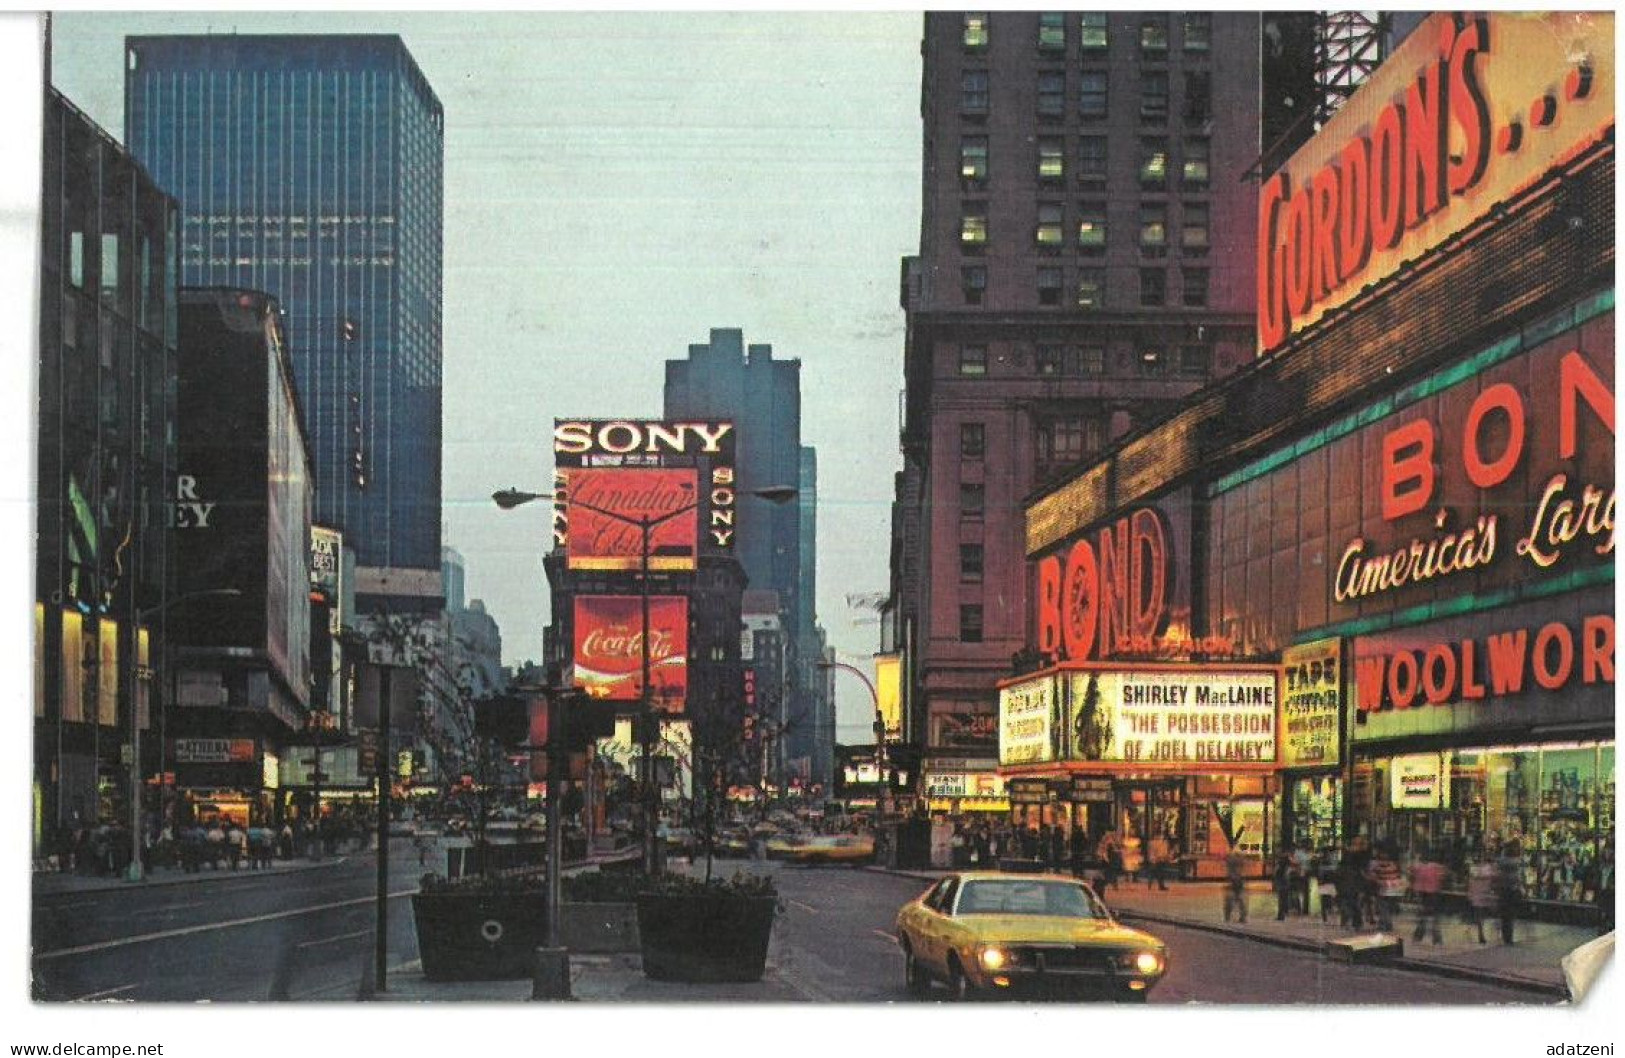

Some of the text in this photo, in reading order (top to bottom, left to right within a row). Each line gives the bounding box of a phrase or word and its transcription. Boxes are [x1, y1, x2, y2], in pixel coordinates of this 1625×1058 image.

[554, 421, 733, 453] SONY
[710, 466, 734, 546] SONY
[1335, 508, 1496, 601] America's
[1039, 508, 1165, 661] BOND
[1284, 657, 1336, 692] TAPE
[1355, 615, 1615, 712] WOOLWOR
[1123, 685, 1273, 706] SHIRLEY MacLAINE
[1167, 713, 1272, 735] POSSESSION
[1123, 740, 1143, 761] OF
